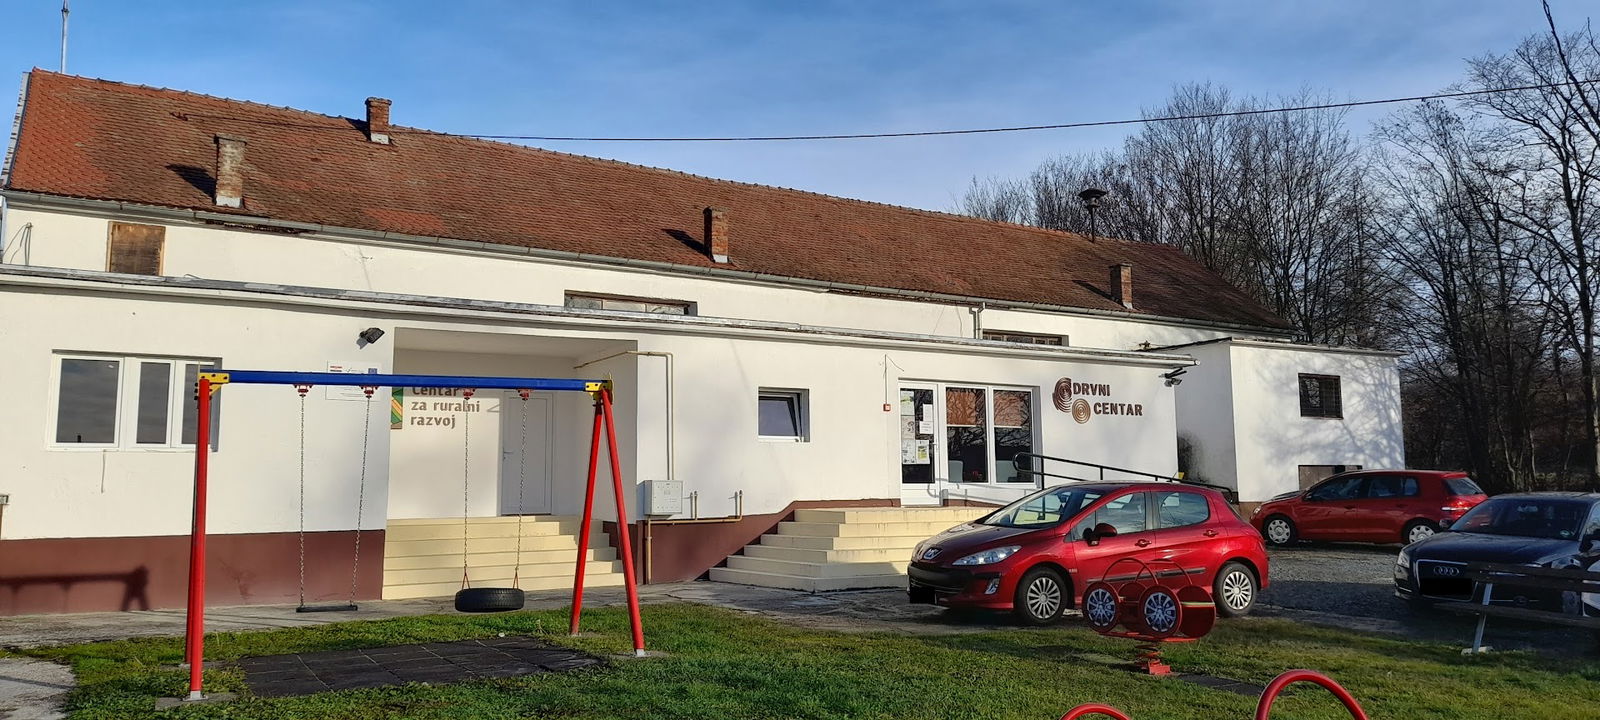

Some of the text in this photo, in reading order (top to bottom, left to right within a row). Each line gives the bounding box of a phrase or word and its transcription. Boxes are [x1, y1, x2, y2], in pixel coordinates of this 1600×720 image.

[1073, 382, 1110, 396] DRVNI
[411, 400, 480, 412] za ruralni
[1093, 402, 1143, 416] CENTAR
[410, 415, 455, 429] razvoj
